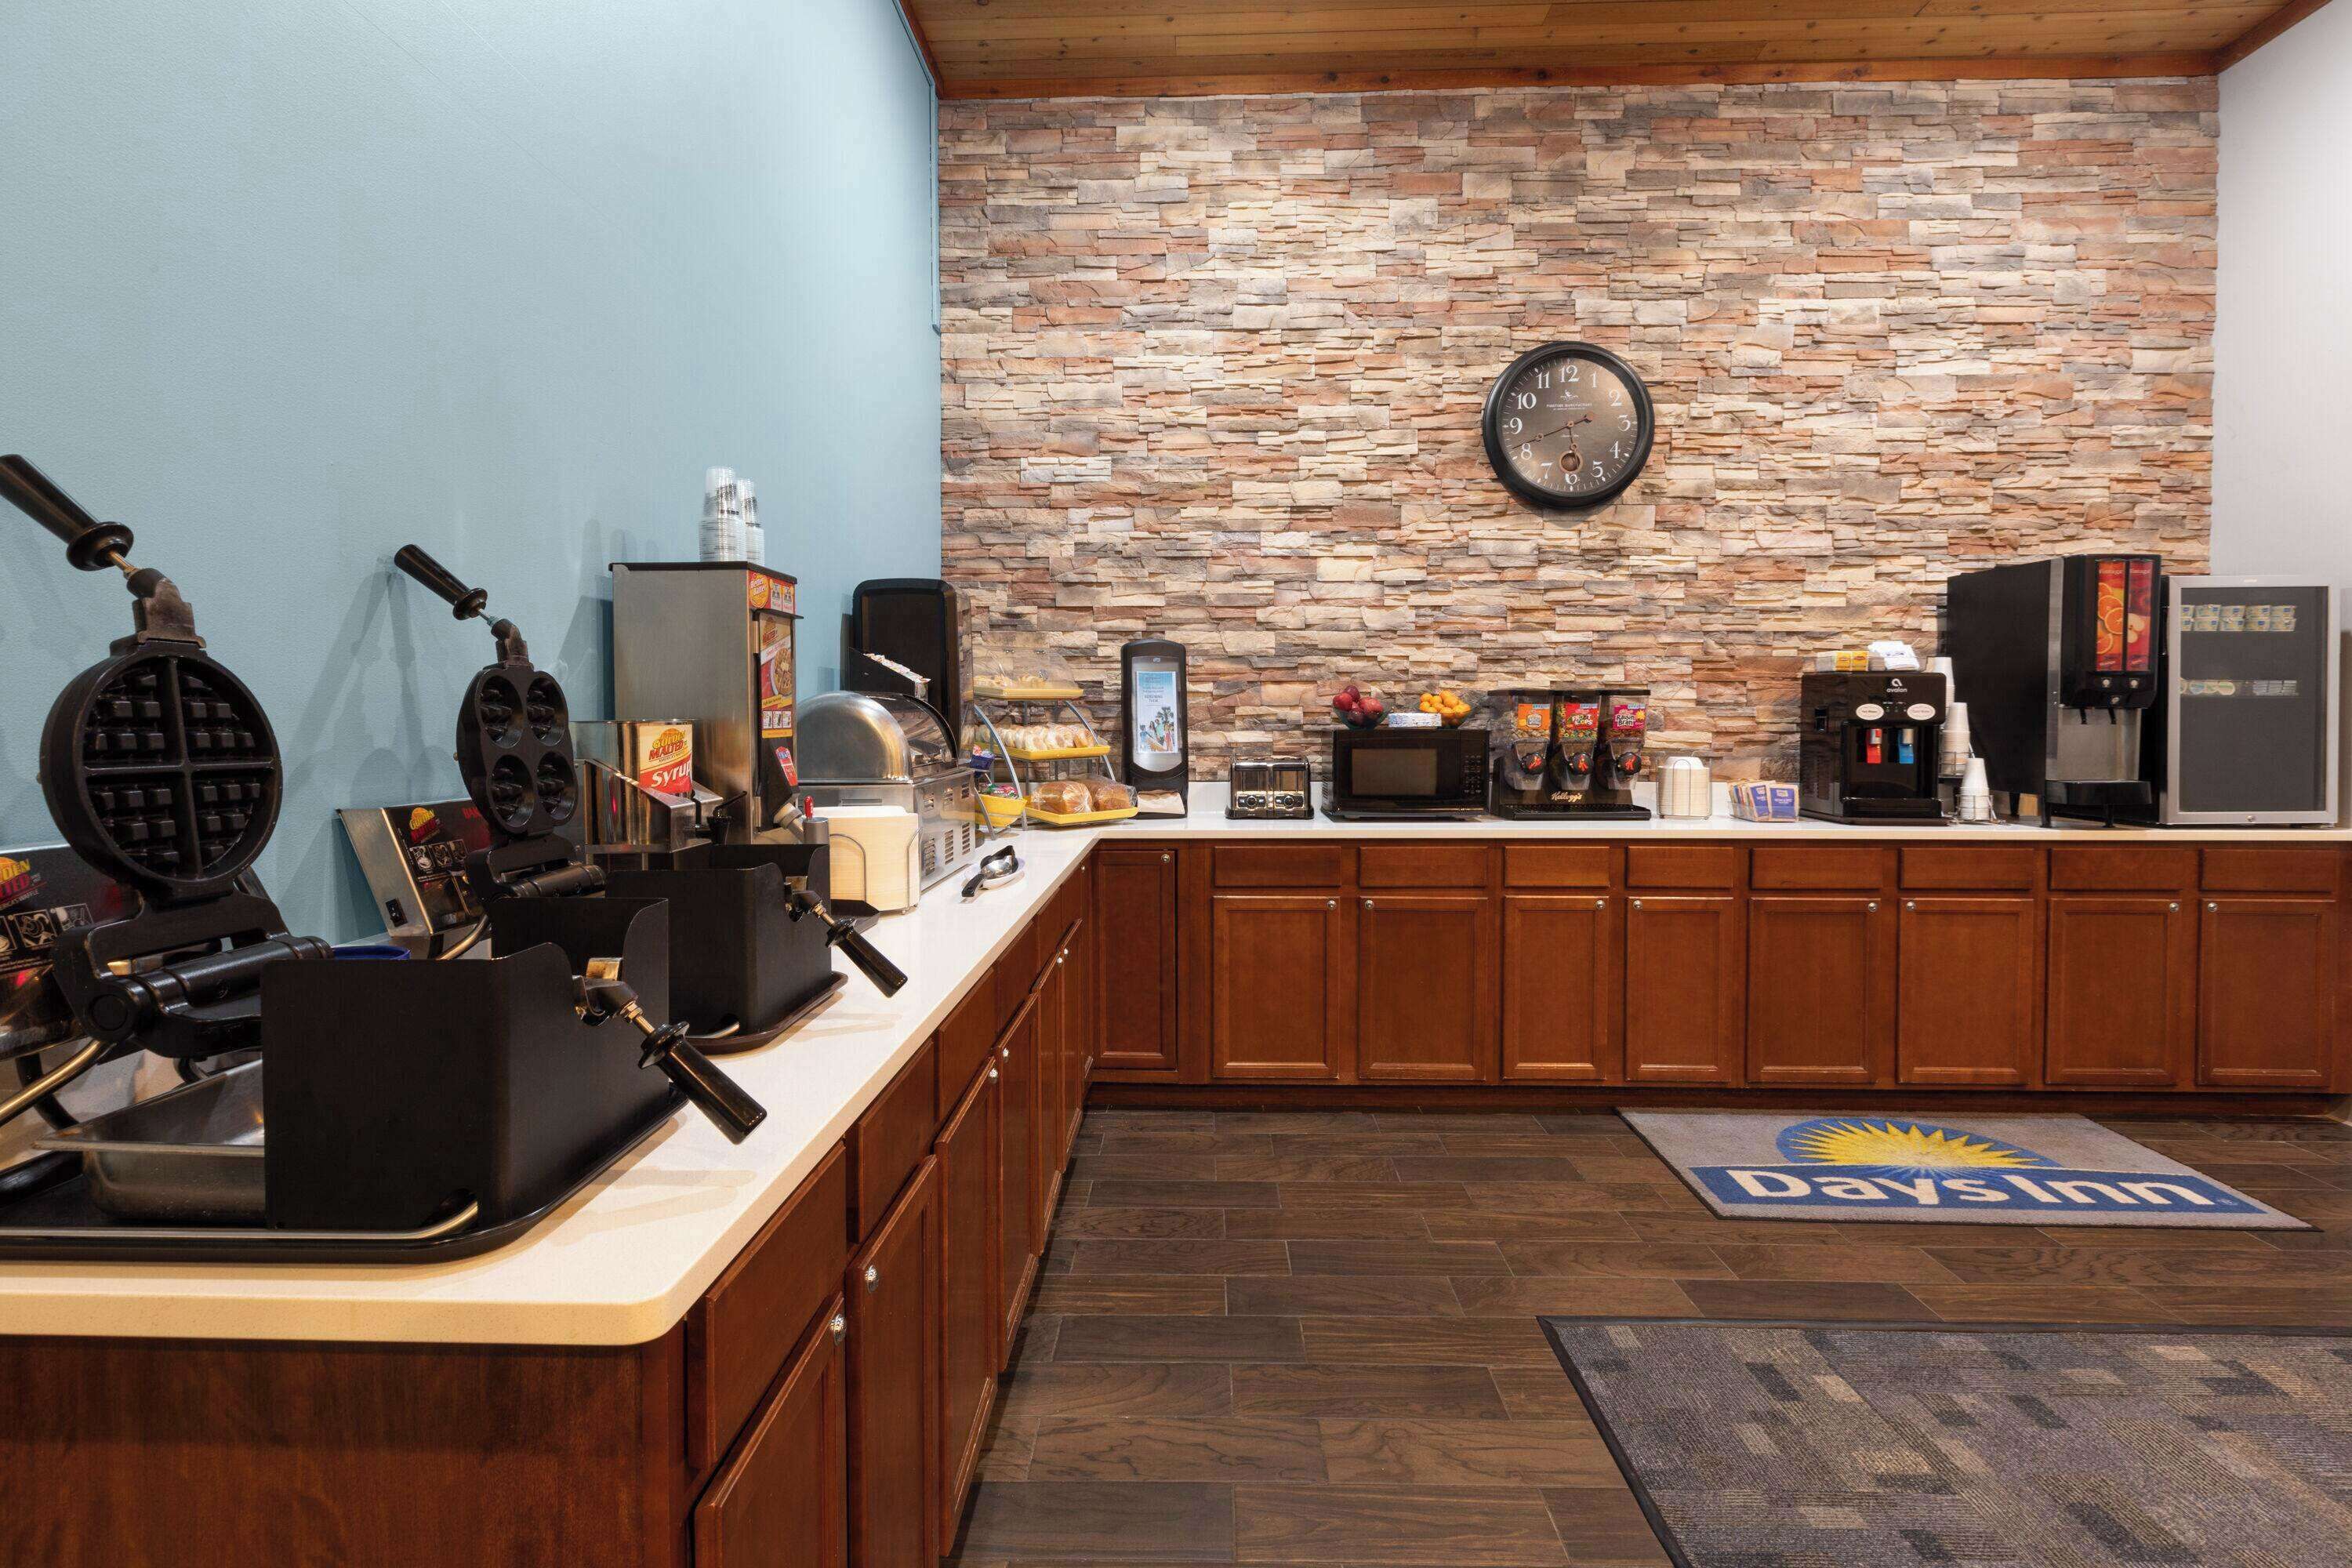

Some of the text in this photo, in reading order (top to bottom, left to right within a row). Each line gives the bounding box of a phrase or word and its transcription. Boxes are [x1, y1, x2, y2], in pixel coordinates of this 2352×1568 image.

[1536, 372, 1551, 389] 11
[1559, 365, 1580, 383] 12
[1590, 372, 1598, 389] 1
[1516, 392, 1537, 410] 10
[1609, 390, 1622, 407] 2
[1509, 417, 1523, 435] 9
[1617, 415, 1631, 432] 3
[1521, 442, 1533, 460] 8
[1609, 441, 1621, 459] 4
[1540, 462, 1553, 480] 7
[1592, 461, 1604, 478] 5
[651, 753, 693, 787] Syrup
[1551, 790, 1583, 803] Kellogg's
